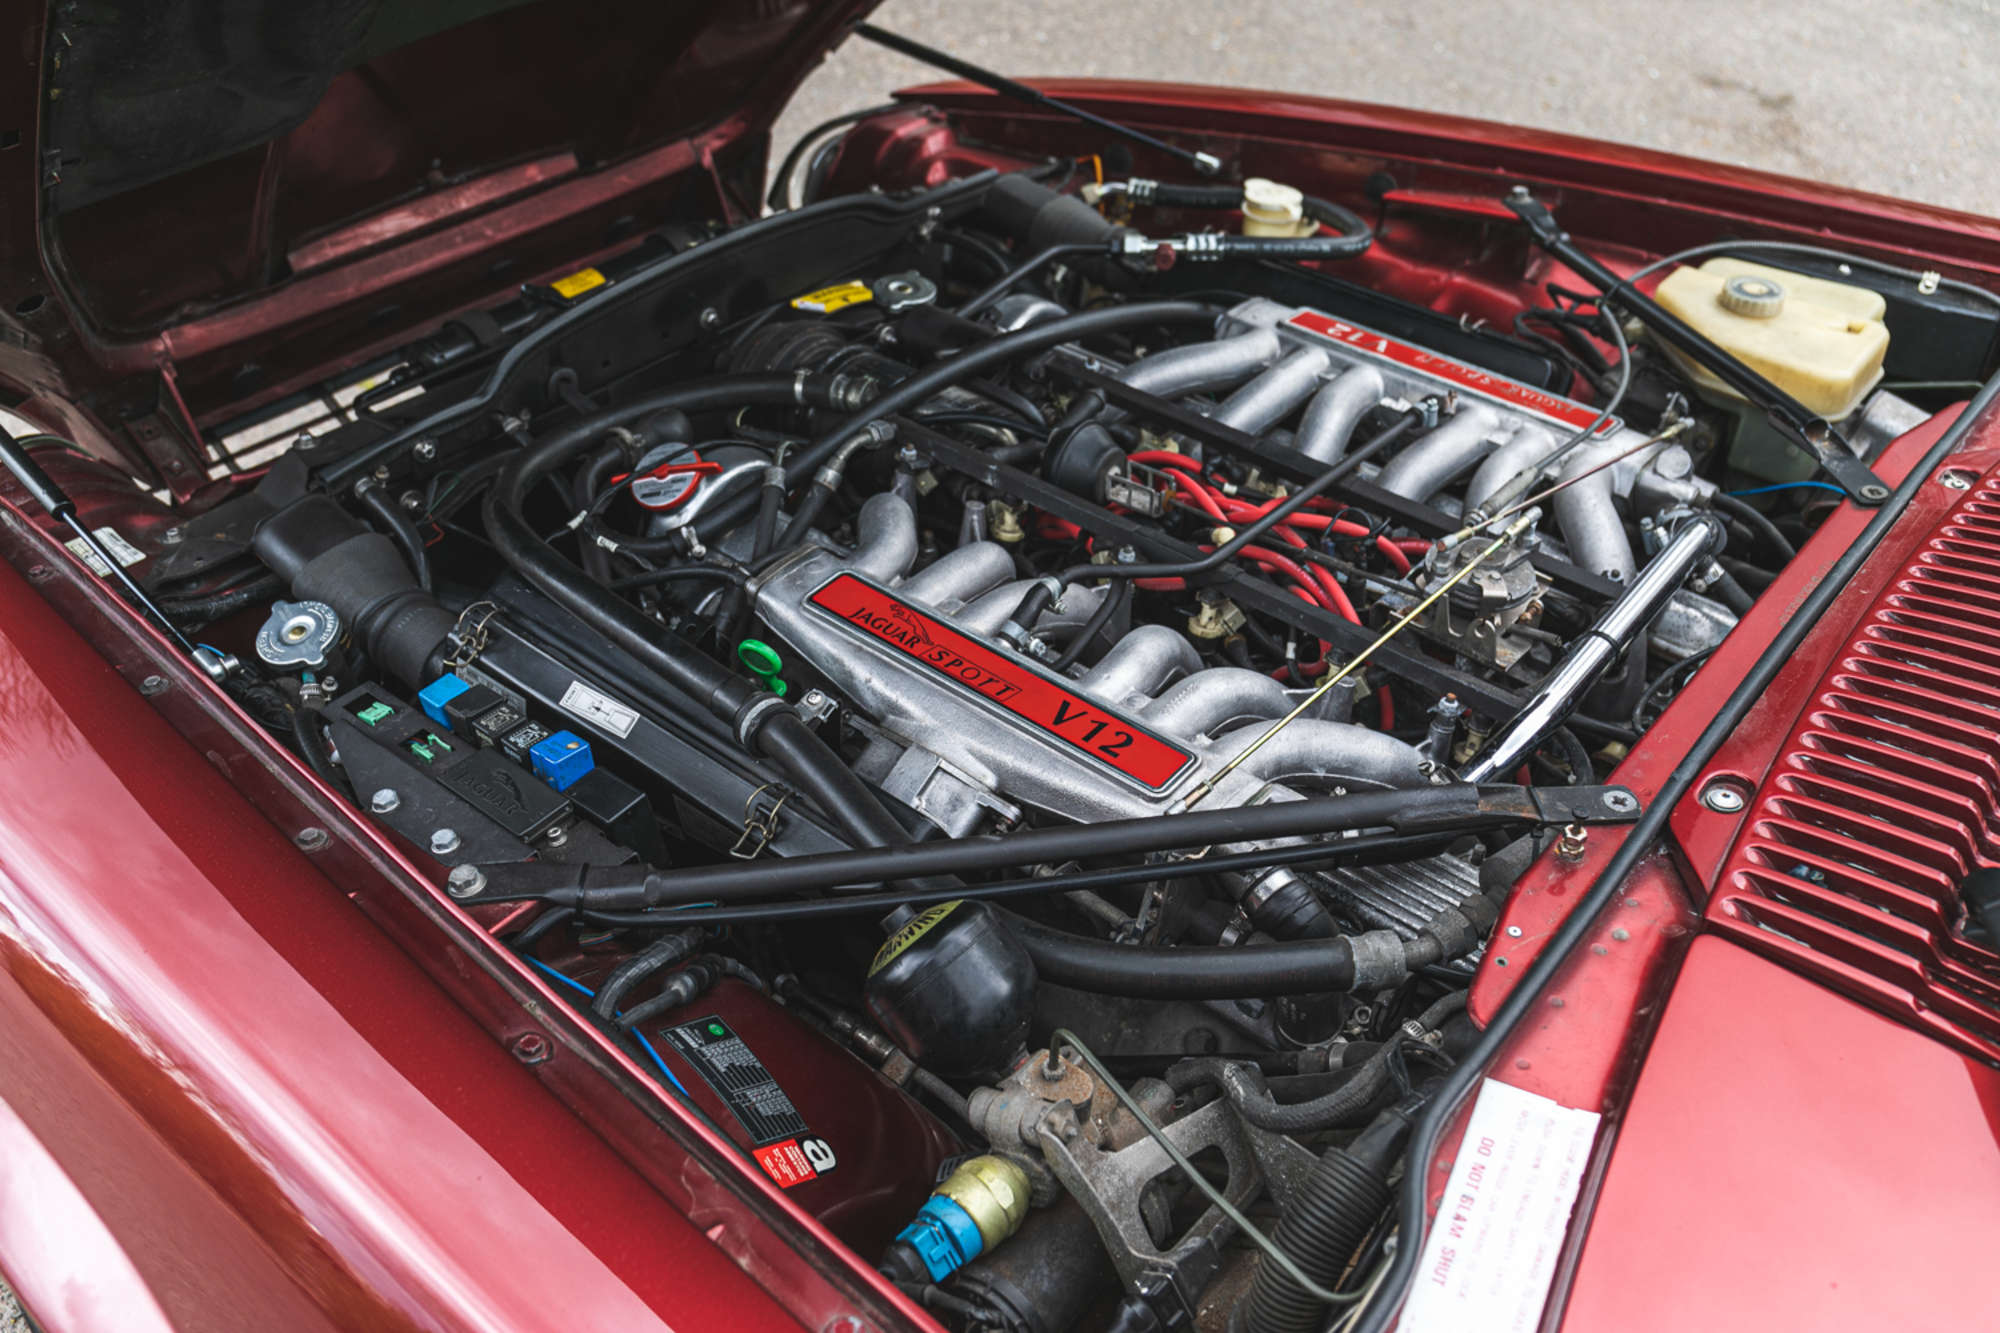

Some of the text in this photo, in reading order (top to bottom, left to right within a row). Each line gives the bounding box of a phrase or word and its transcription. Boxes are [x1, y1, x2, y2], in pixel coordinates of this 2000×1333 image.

[1327, 322, 1388, 353] V12
[850, 607, 921, 649] JAGUAR
[1053, 700, 1133, 758] V12
[1477, 1136, 1495, 1157] DO
[1466, 1163, 1486, 1190] NOT
[1432, 1246, 1456, 1288] SHUT
